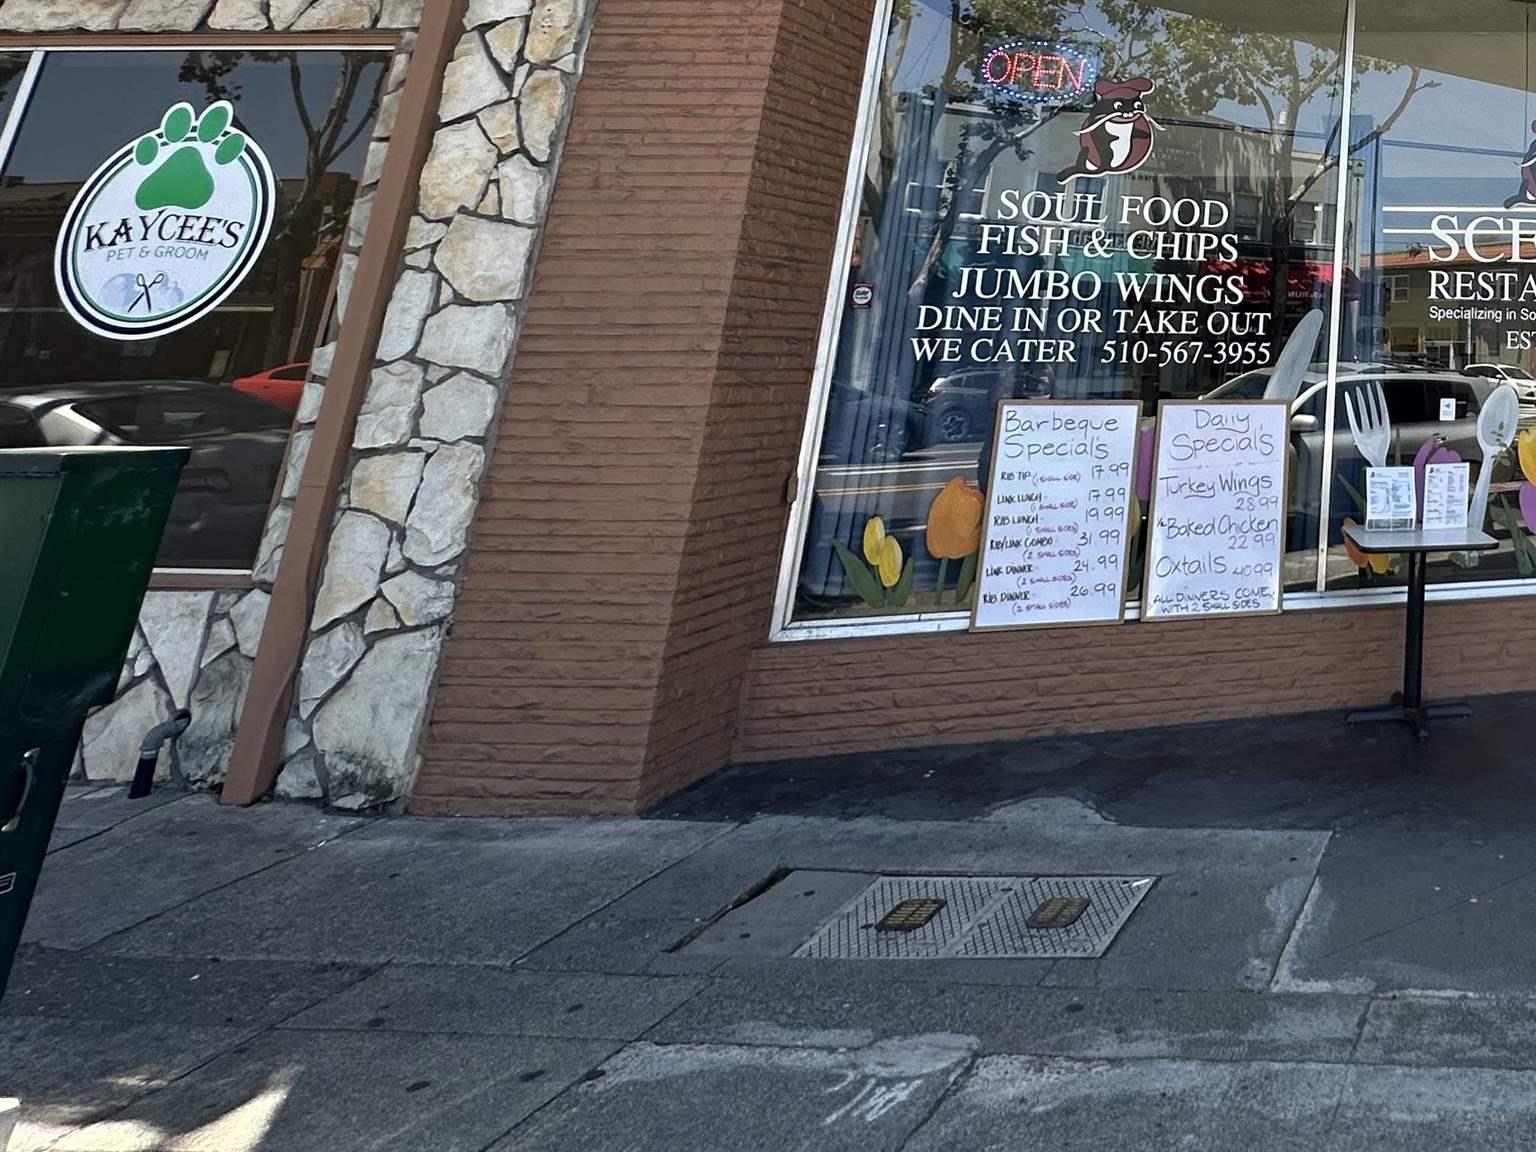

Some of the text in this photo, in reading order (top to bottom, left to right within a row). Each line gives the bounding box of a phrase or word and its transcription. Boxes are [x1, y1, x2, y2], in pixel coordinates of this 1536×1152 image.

[986, 51, 1087, 92] OPEN
[997, 190, 1229, 228] SOUL FOOD
[84, 209, 246, 252] KAYCEE'S
[976, 224, 1071, 258] FISH
[1083, 228, 1115, 258] &
[1127, 230, 1239, 263] CHIPS
[106, 245, 209, 262] PET & GROOM
[952, 267, 1244, 306] JUMBO WINGS
[916, 305, 1272, 336] DINE IN OR TAKE OUT
[1429, 305, 1503, 323] Specializing
[1506, 307, 1516, 320] in
[911, 337, 1271, 367] WE CATER 510-567-3955
[1005, 410, 1119, 440] Barbeque
[1159, 471, 1273, 499] Turkey Wings
[1167, 516, 1216, 540] Baked
[1218, 513, 1278, 535] Chicken
[1154, 594, 1173, 604] ALL
[1161, 603, 1189, 614] WITH
[1192, 603, 1200, 612] 2
